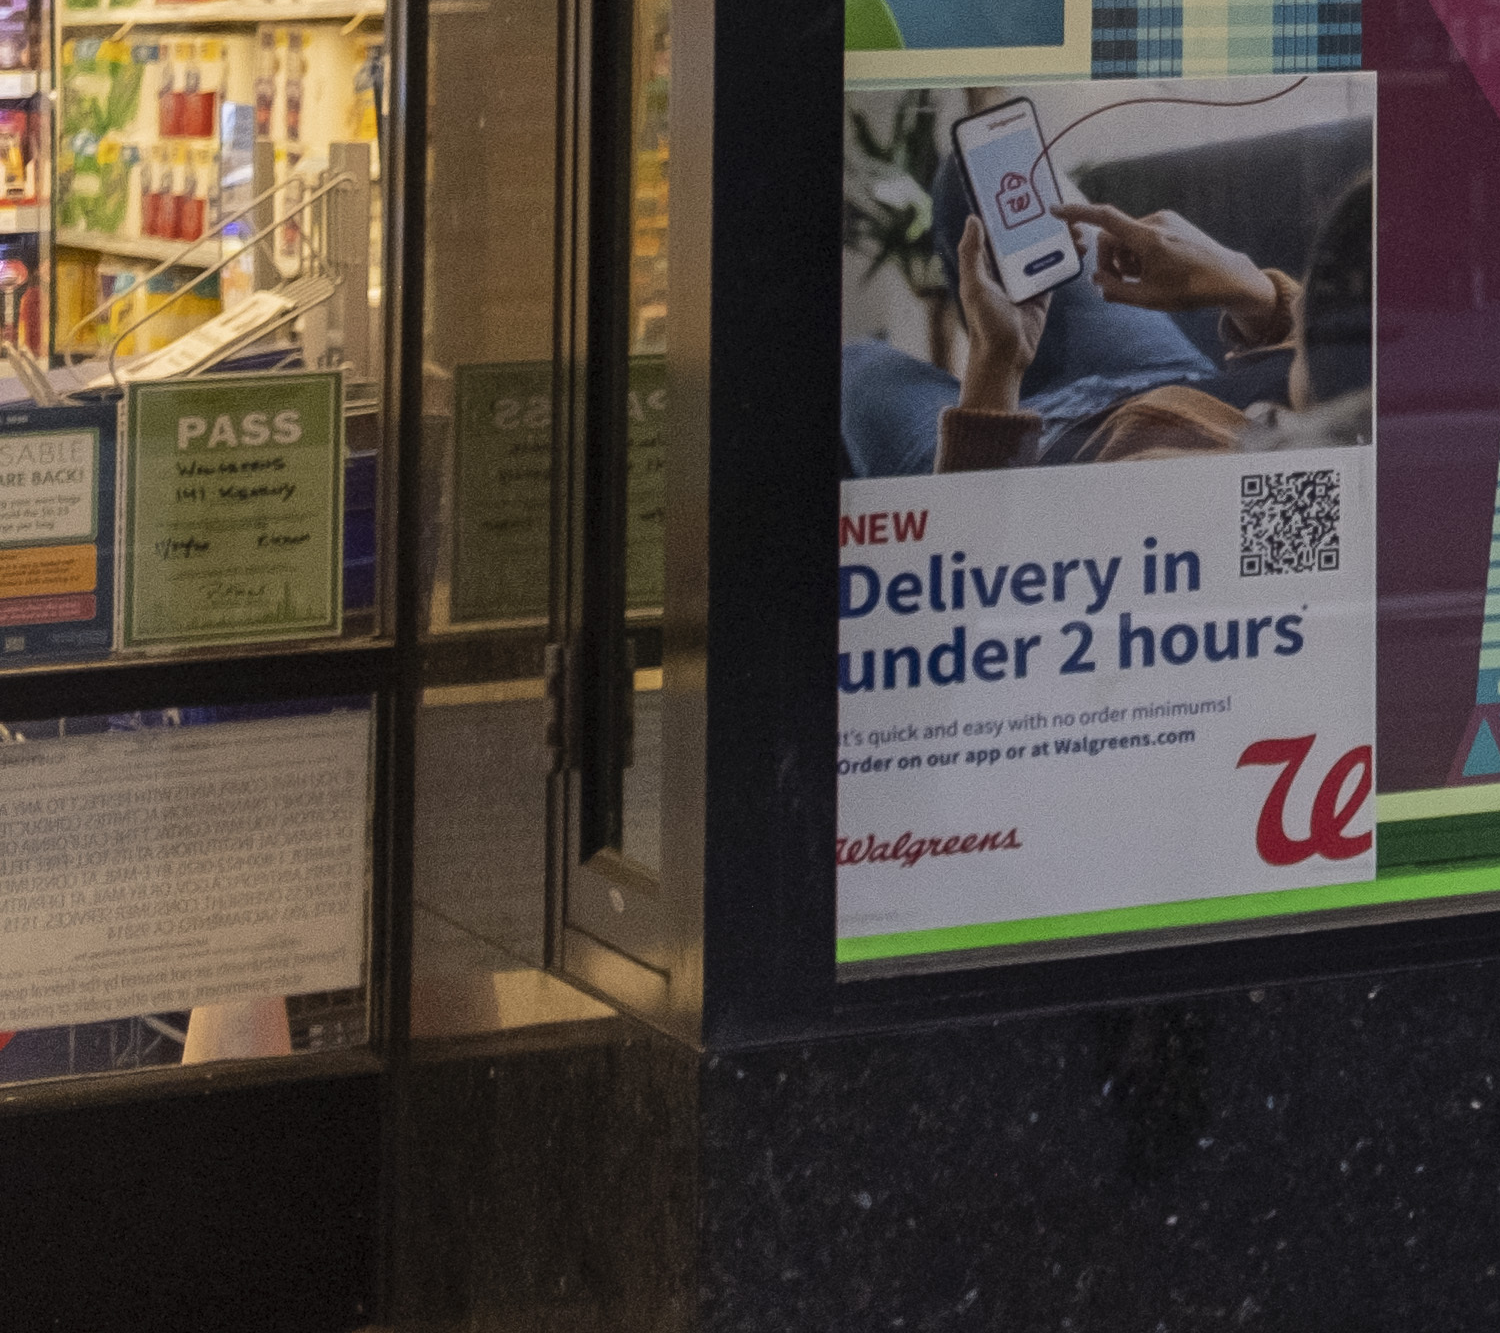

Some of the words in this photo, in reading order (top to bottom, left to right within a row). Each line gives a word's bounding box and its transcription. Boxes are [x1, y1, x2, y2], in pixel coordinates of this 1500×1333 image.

[177, 411, 302, 449] PASS
[840, 510, 929, 547] NEW
[839, 551, 1122, 620] Delivery
[1143, 536, 1200, 595] in
[839, 626, 1041, 695] under
[1058, 620, 1097, 675] 2
[868, 724, 918, 748] quick
[923, 721, 957, 741] and
[962, 720, 1003, 739] easy
[1007, 712, 1047, 731] with
[1052, 714, 1075, 727] no
[1079, 707, 1127, 726] order
[1132, 696, 1232, 720] minimums!
[837, 757, 892, 776] Order
[898, 756, 922, 769] on
[927, 752, 959, 767] our
[964, 746, 1000, 767] app
[1006, 744, 1026, 758] or
[1031, 741, 1050, 757] at
[1054, 730, 1196, 756] Walgreens.com
[836, 827, 1023, 869] Walgreens
